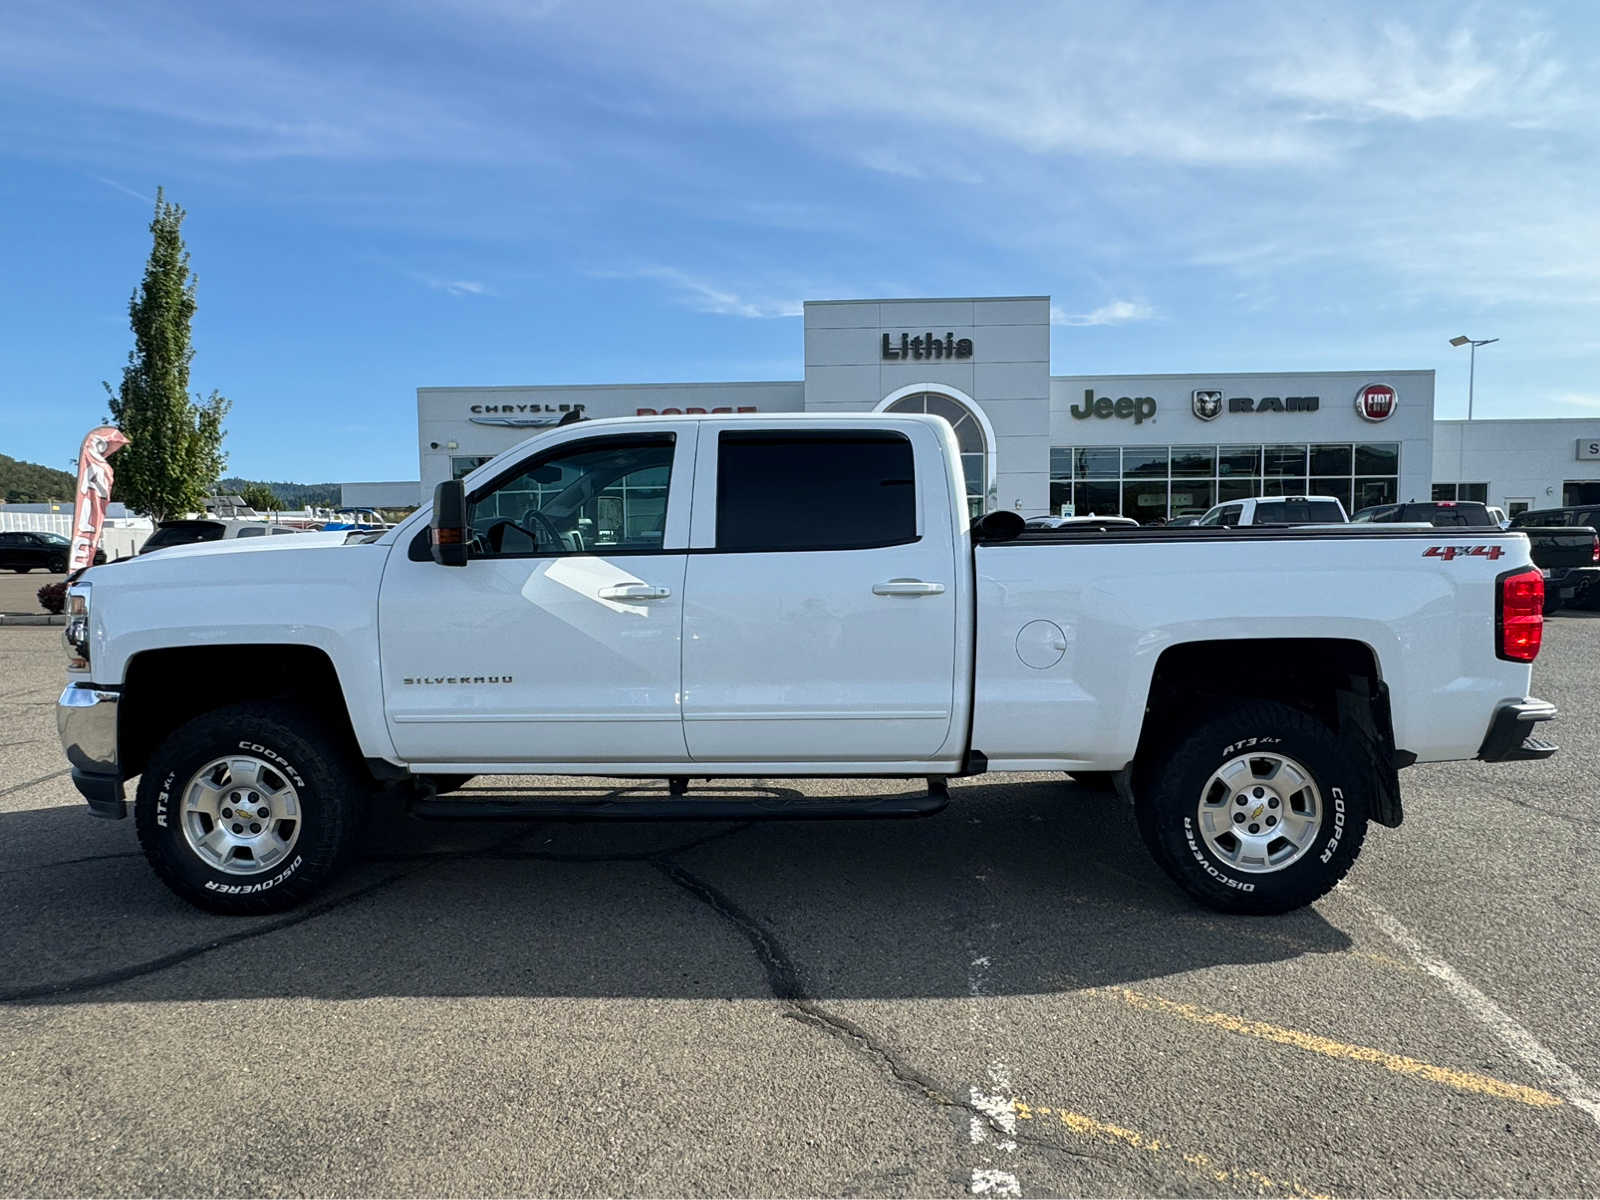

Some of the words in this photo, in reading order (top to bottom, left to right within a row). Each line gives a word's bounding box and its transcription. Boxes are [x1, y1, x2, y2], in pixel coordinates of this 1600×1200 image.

[882, 331, 973, 361] Lithia
[470, 404, 586, 414] CHRYSLER
[1070, 389, 1157, 425] Jeep
[1229, 397, 1320, 413] RAM
[1368, 394, 1391, 411] FIAT
[239, 741, 305, 787] COOPER
[1223, 737, 1257, 757] AT3
[157, 792, 169, 827] AT3
[1320, 787, 1345, 864] COOPER
[1184, 817, 1255, 892] DISCOVERER
[205, 856, 302, 894] DISCOVERER
